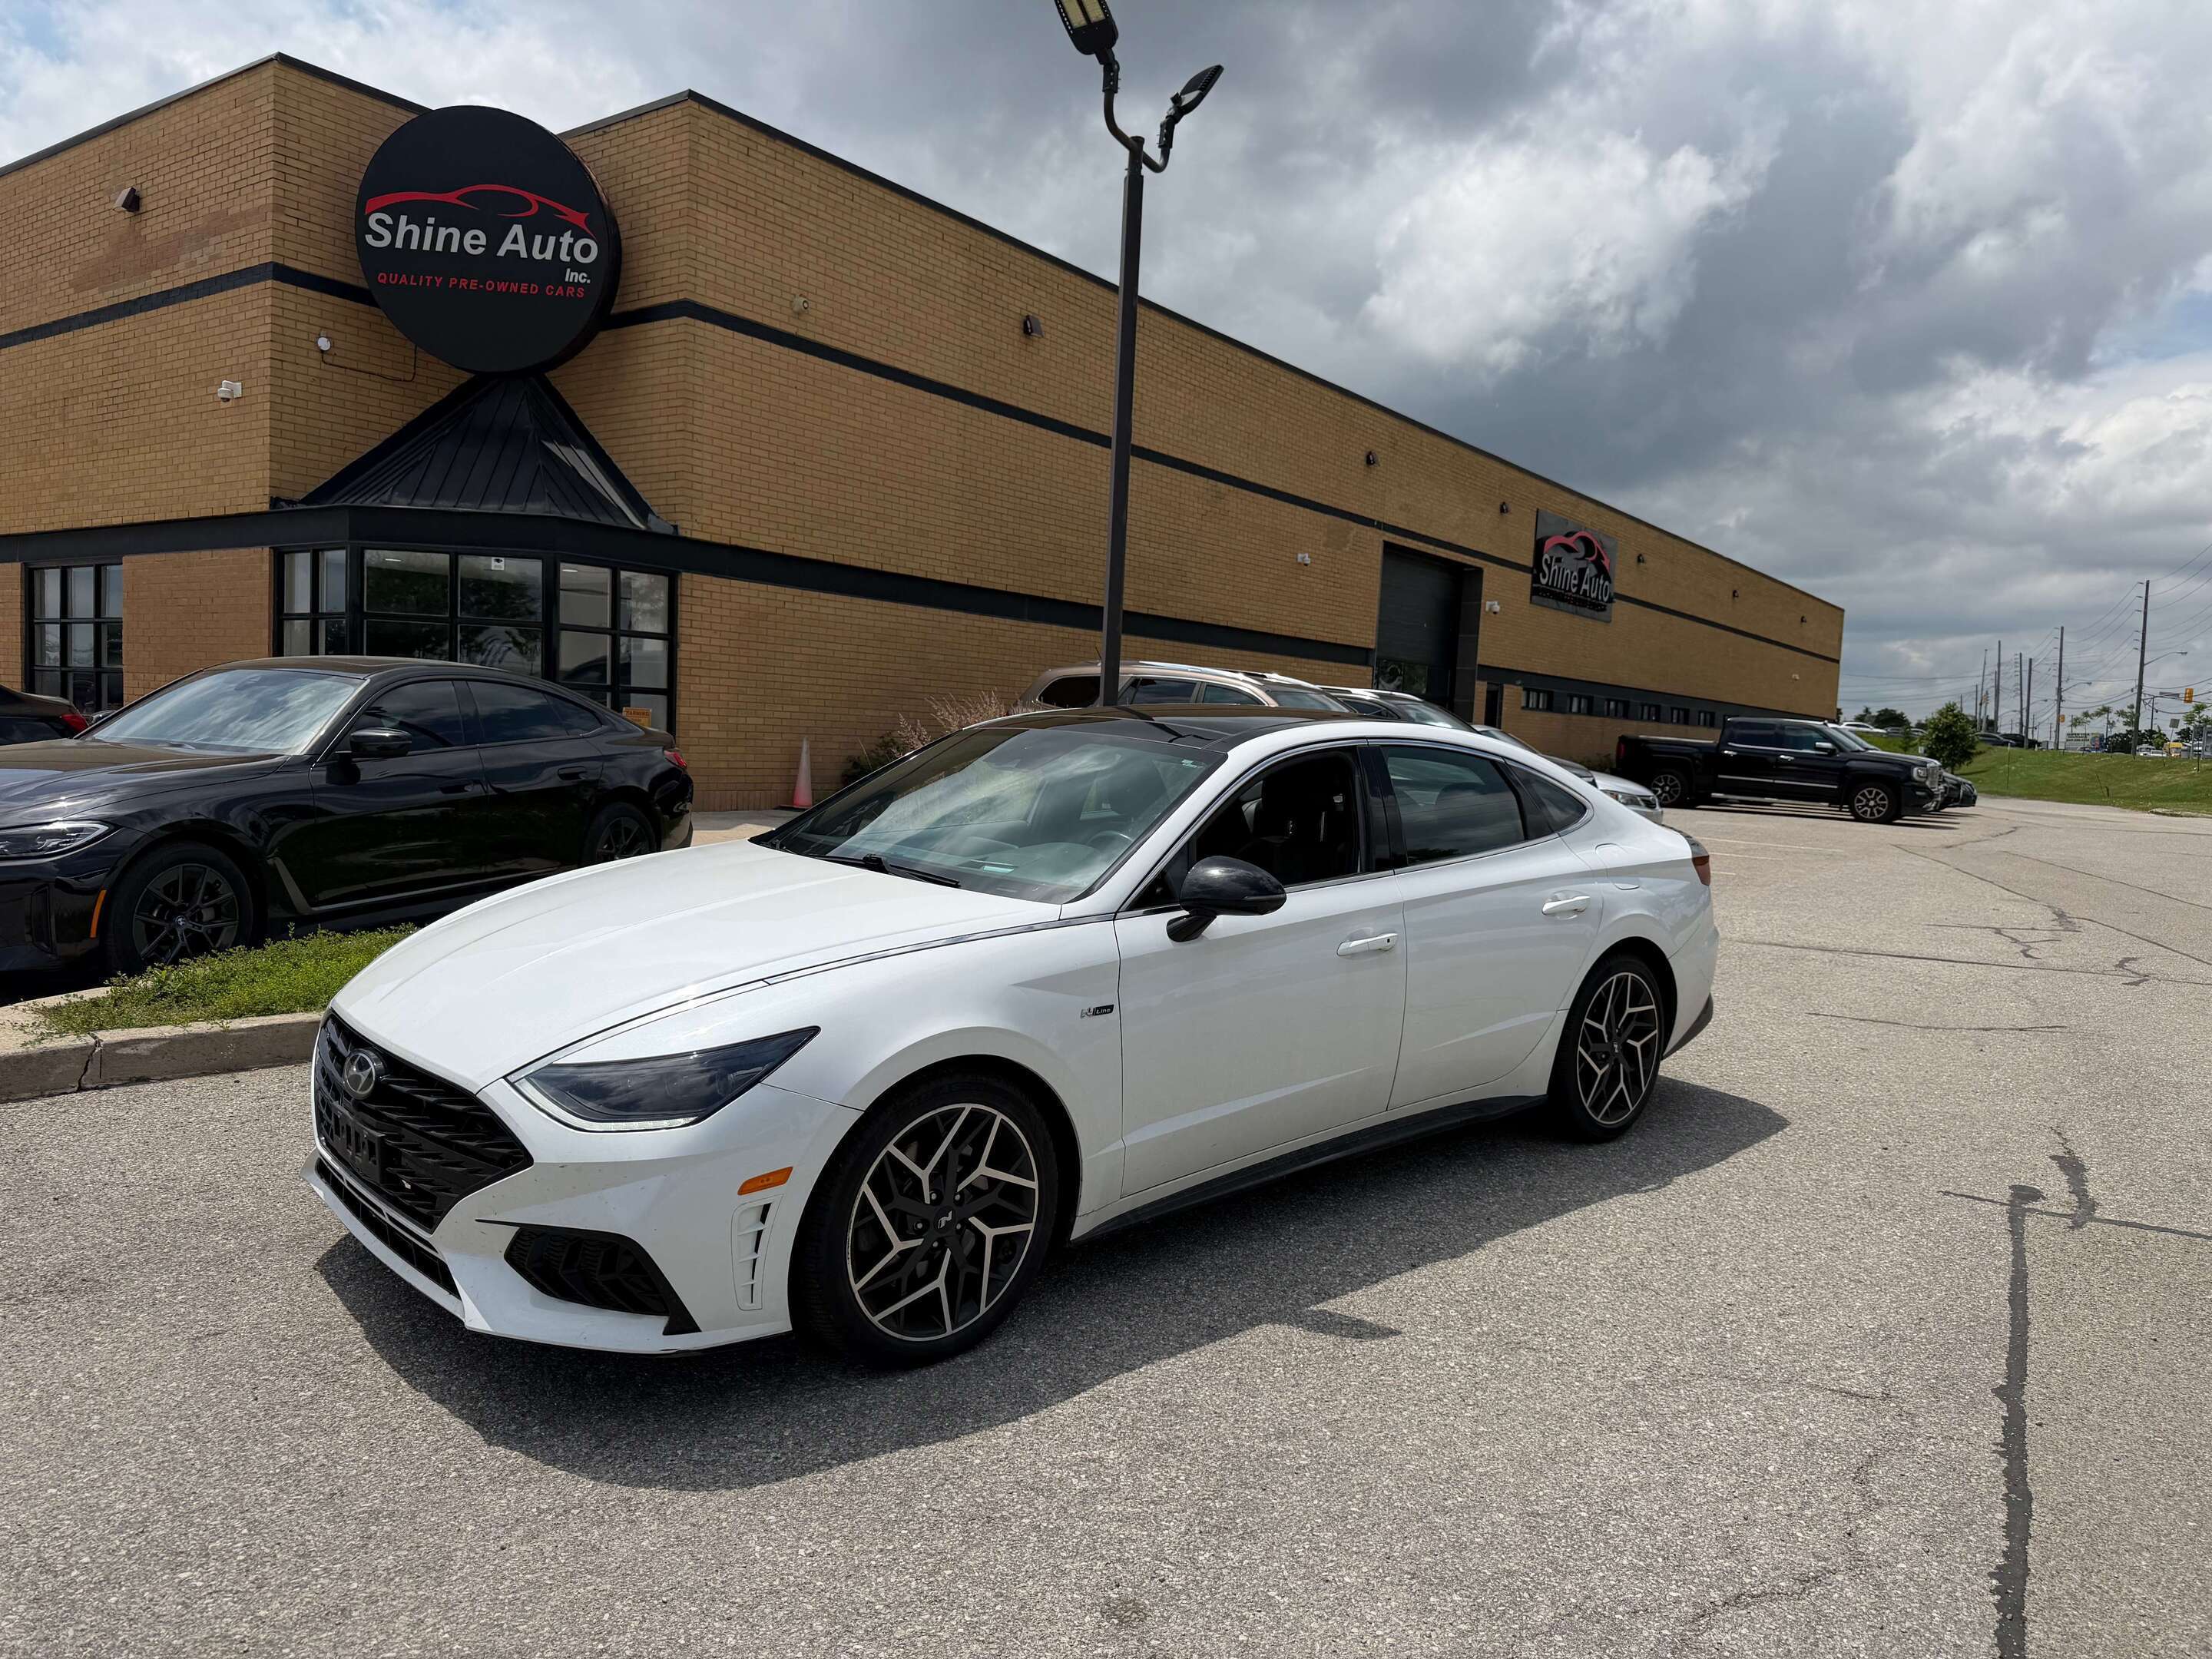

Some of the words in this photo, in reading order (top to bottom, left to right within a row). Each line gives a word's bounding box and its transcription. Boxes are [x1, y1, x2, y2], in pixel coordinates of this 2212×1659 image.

[365, 212, 486, 255] Shine
[496, 224, 598, 264] Auto
[377, 273, 442, 287] QUALITY
[449, 277, 538, 294] PRE-OWNED
[545, 285, 584, 298] CARS
[565, 268, 591, 283] Inc.
[1539, 554, 1578, 592] Shine
[1580, 568, 1609, 602] Auto
